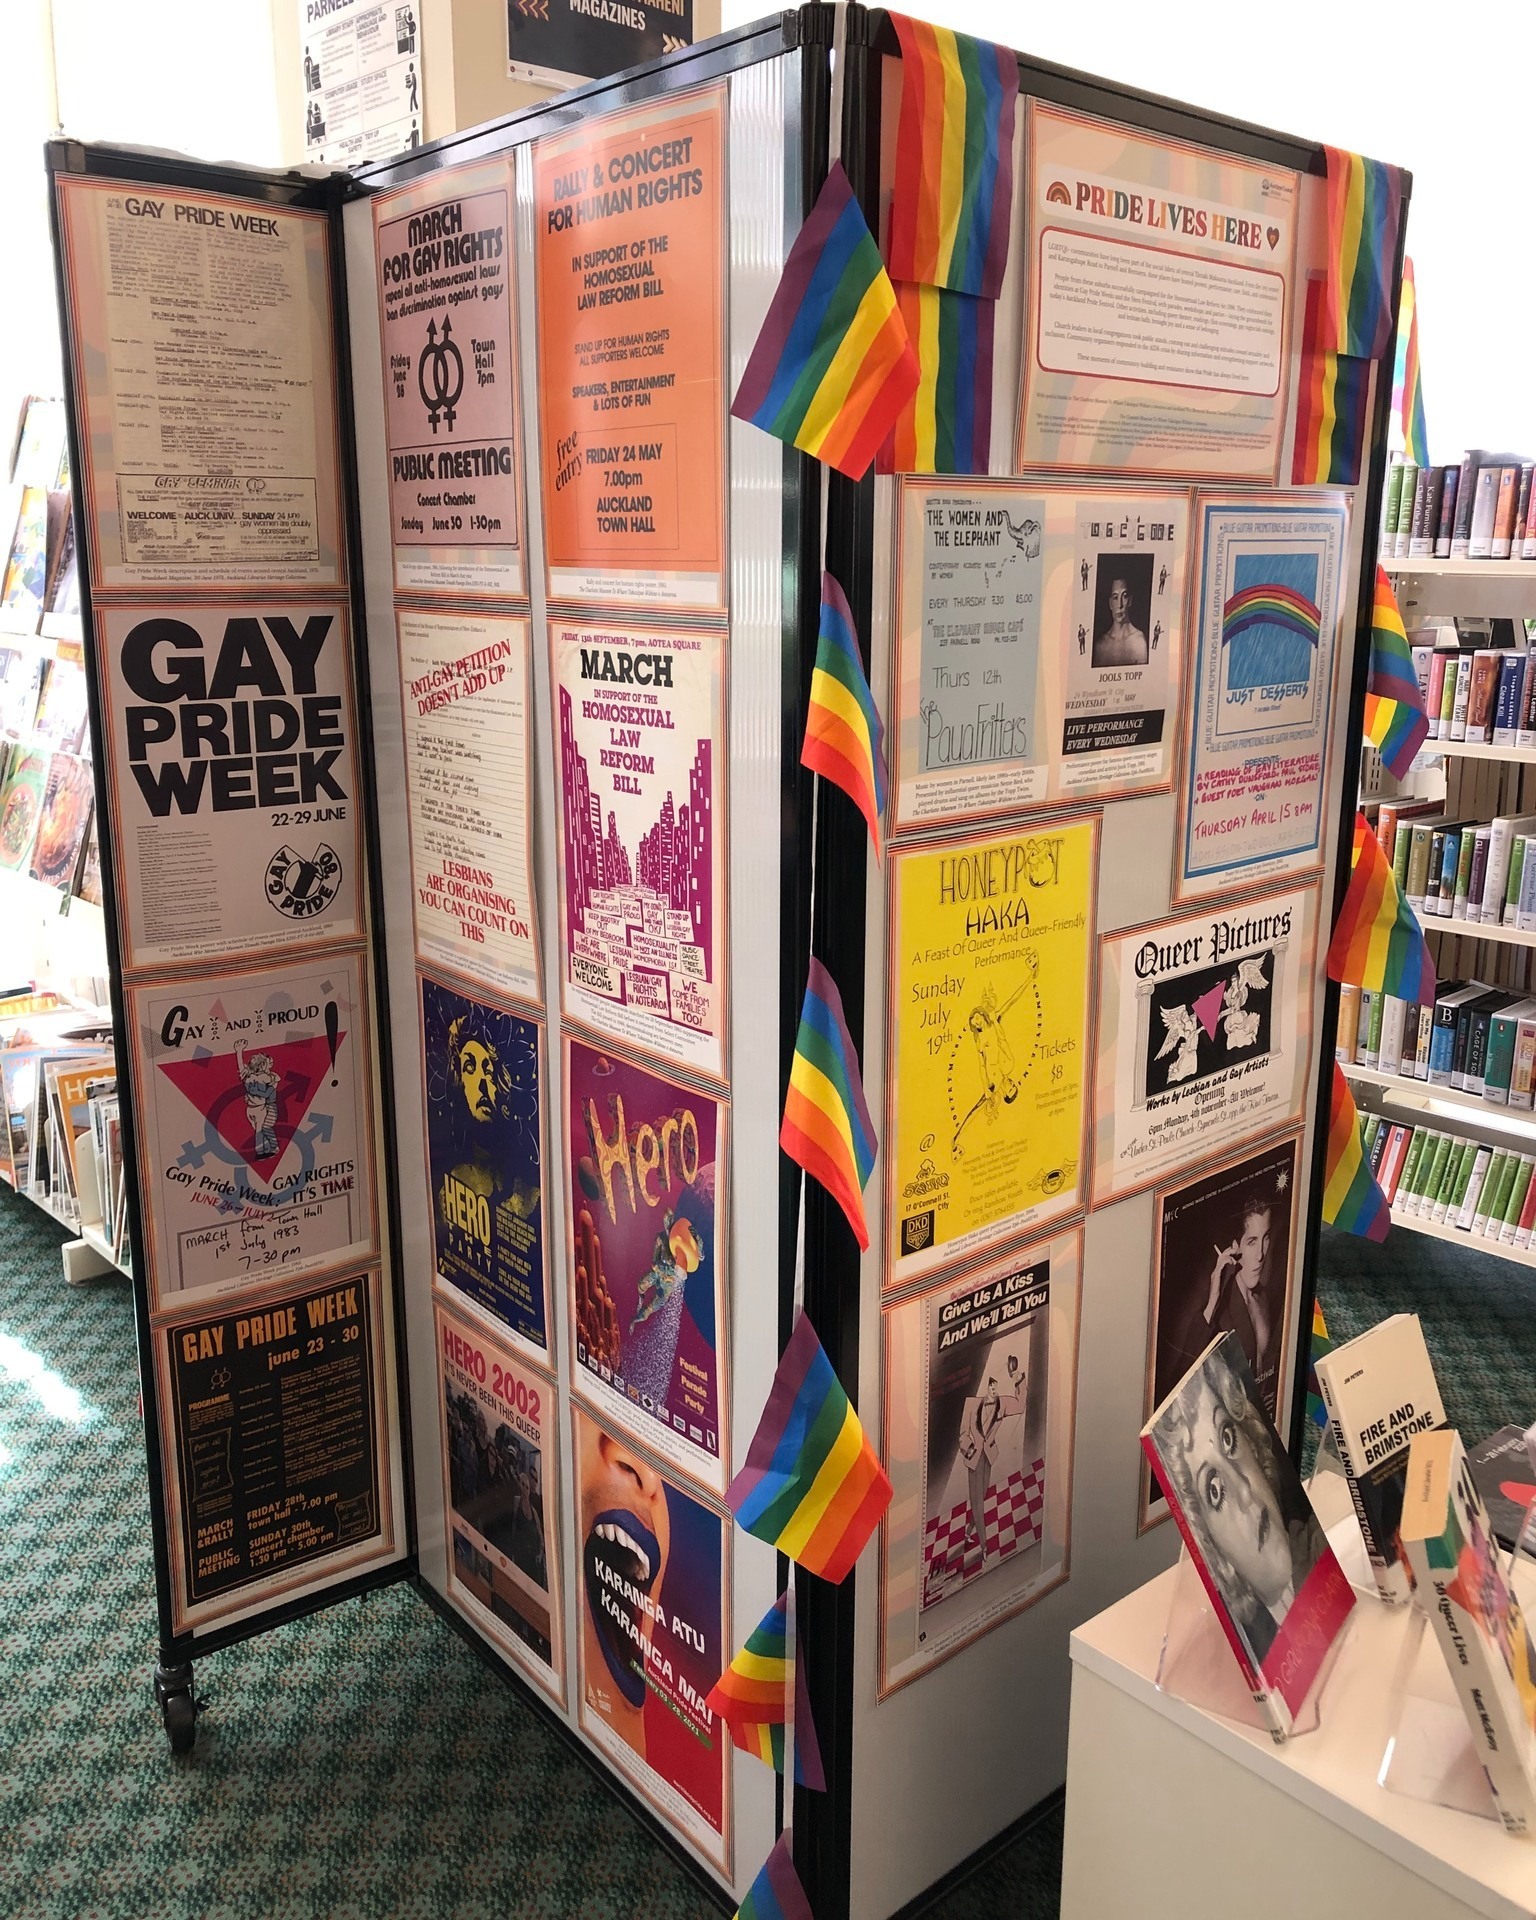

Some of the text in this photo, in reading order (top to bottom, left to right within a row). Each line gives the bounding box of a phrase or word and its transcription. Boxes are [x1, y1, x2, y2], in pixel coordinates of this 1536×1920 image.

[570, 0, 646, 30] MAGAZINES
[553, 136, 693, 202] RALLY & CONCERT
[125, 198, 279, 237] GAY PRIDE WEEK
[408, 203, 463, 248] MARCH
[1075, 181, 1262, 250] PRIDE LIVES HERE
[383, 226, 503, 286] FOR GAY RIGHTS
[584, 260, 654, 290] HOMOSEXUAL
[393, 447, 511, 482] PUBLIC MEETING
[586, 443, 663, 464] FRIDAY 24 MAY
[596, 496, 652, 513] AUCKLAND
[1425, 486, 1434, 503] Kate
[126, 511, 275, 520] WELCOME SUNDAY
[239, 520, 249, 528] gay
[290, 519, 311, 528] doubly
[927, 510, 1003, 526] THE WOMEN AND
[934, 531, 1001, 546] THE ELEPHANT
[929, 597, 986, 609] EVERY THURSDAY
[648, 639, 701, 650] AOTEA SQUARE
[120, 615, 334, 704] GAY
[410, 638, 511, 700] ANTI-GAY PETITION
[580, 649, 673, 687] MARCH
[932, 666, 1002, 688] Thurs 12th
[1099, 671, 1143, 682] JOOLS TOPP
[1226, 683, 1308, 705] JUST DESSERTS
[1499, 686, 1507, 707] Clean
[582, 701, 675, 729] HOMOSEXUAL
[1066, 718, 1144, 735] LIVE PERFORMANCE
[1507, 701, 1515, 727] LEATHER
[125, 696, 345, 762] PRIDE
[610, 728, 641, 748] LAW
[600, 749, 654, 774] REFORM
[129, 749, 349, 817] WEEK
[613, 774, 642, 795] BILL
[271, 806, 347, 827] 22-29 JUNE
[1194, 808, 1276, 840] THURSDAY APRIL
[268, 850, 292, 896] GAY
[442, 859, 493, 889] LESBIANS
[279, 885, 335, 917] PRIDE
[426, 873, 516, 915] ARE ORGANISING
[419, 888, 529, 940] YOU CAN COUNT ON
[966, 897, 1030, 937] HAKA
[1020, 912, 1087, 940] Queer-Friendly
[459, 920, 485, 944] THIS
[1134, 906, 1293, 979] Queer Pictures
[572, 957, 609, 979] EVERYONE
[974, 946, 1031, 969] Performance
[574, 970, 613, 992] WELCOME
[632, 984, 658, 997] RIGHTS
[912, 974, 966, 1003] Sunday
[635, 994, 668, 1011] AOTEAROA
[675, 999, 706, 1016] FAMILIES
[920, 1003, 952, 1029] July
[681, 1010, 703, 1026] TOO!
[1039, 1037, 1076, 1060] Tickets
[1472, 1030, 1481, 1060] CAGE OF
[1182, 1057, 1270, 1100] Lesbian Artists
[581, 1093, 699, 1225] Hero
[165, 1166, 281, 1208] Gay Pride Week:
[272, 1159, 354, 1191] GAY RIGHTS
[444, 1172, 491, 1248] HERO
[909, 1214, 929, 1233] DKD
[185, 1229, 228, 1249] MARCH
[273, 1226, 299, 1240] 1983
[942, 1272, 1034, 1323] Give Us A Kiss
[182, 1287, 358, 1363] GAY PRIDE WEEK
[267, 1336, 325, 1371] june 23
[443, 1325, 541, 1426] HERO 2002
[456, 1369, 541, 1444] NEVER QUEER
[1359, 1402, 1415, 1448] FIRE AND
[1365, 1411, 1434, 1466] BRIMSTONE
[1331, 1419, 1375, 1560] FIRE AND BRIMSTONE
[246, 1501, 281, 1521] FRIDAY
[197, 1518, 234, 1539] MARCH
[198, 1556, 241, 1579] MEETING
[594, 1556, 706, 1654] KARANGA ATU
[601, 1588, 673, 1683] KARANGA
